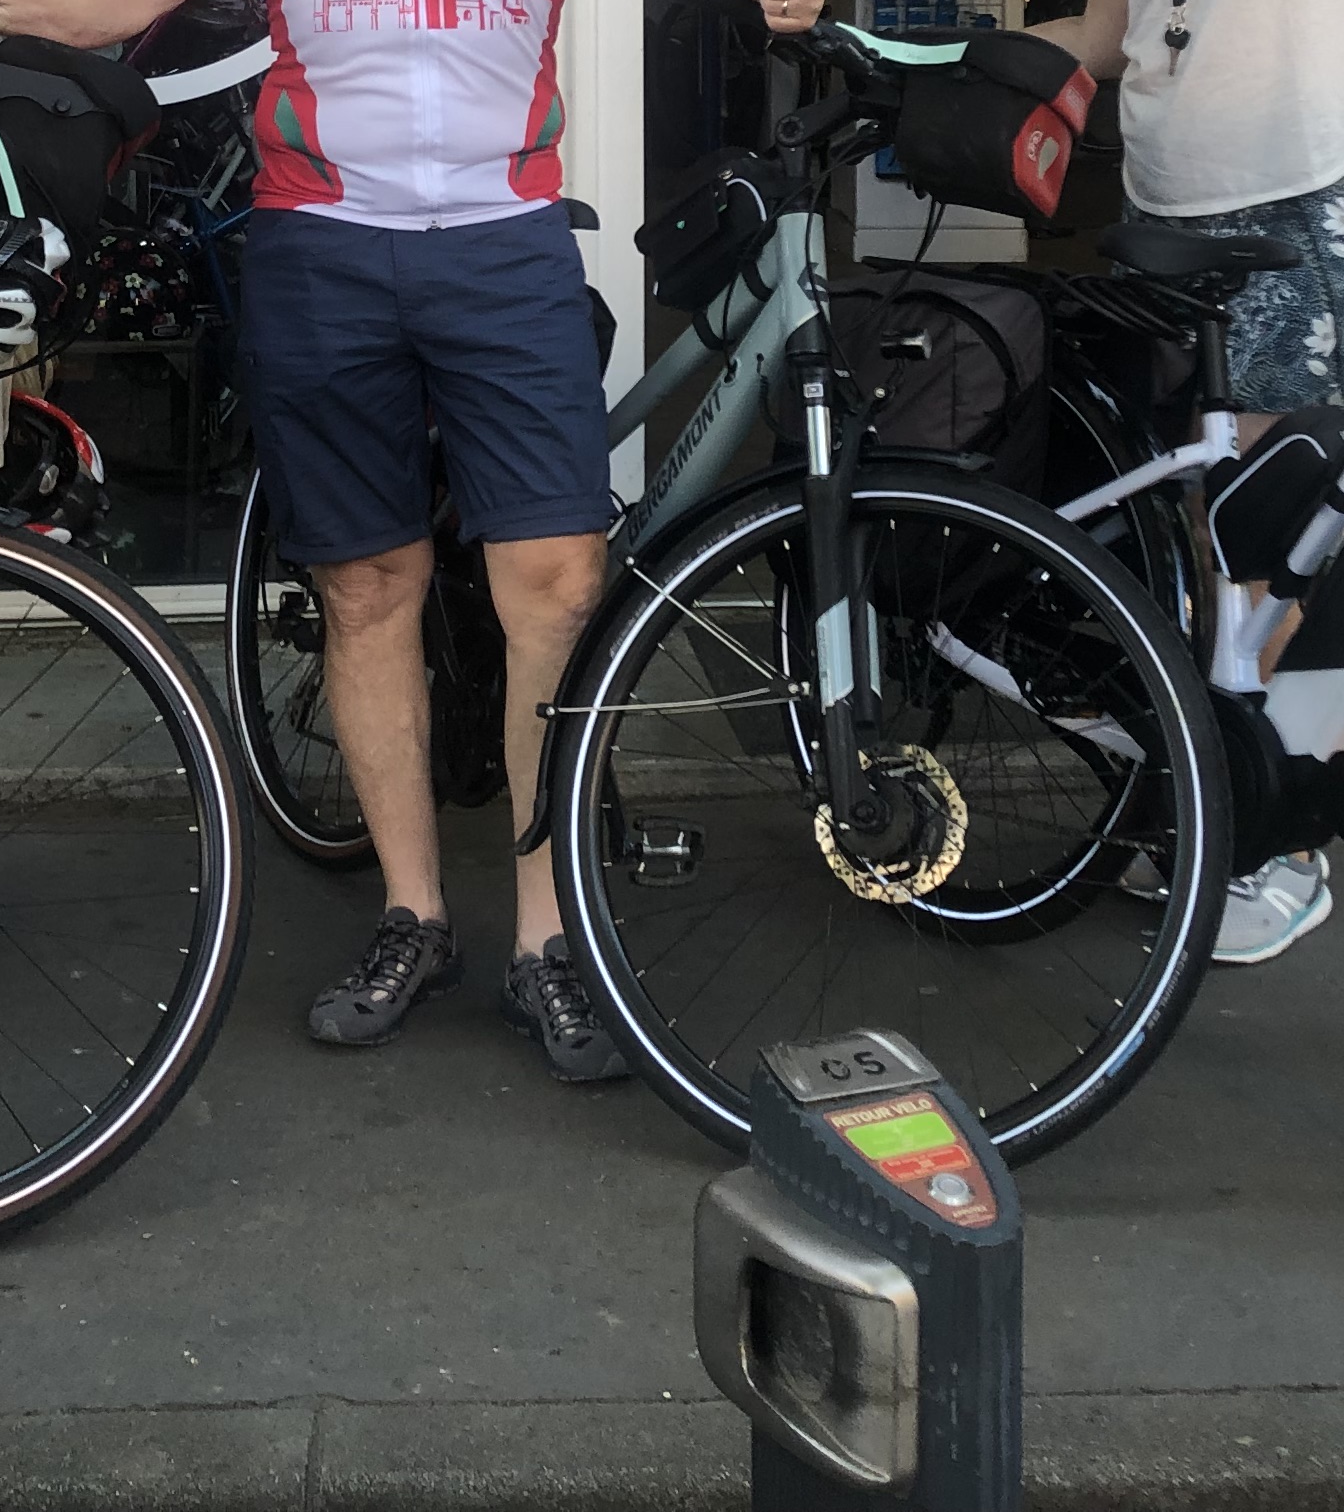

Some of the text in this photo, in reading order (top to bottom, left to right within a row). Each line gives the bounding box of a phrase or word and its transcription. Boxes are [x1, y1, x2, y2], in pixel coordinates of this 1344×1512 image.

[819, 1050, 886, 1081] 05
[831, 1098, 933, 1128] RETOUR VELO
